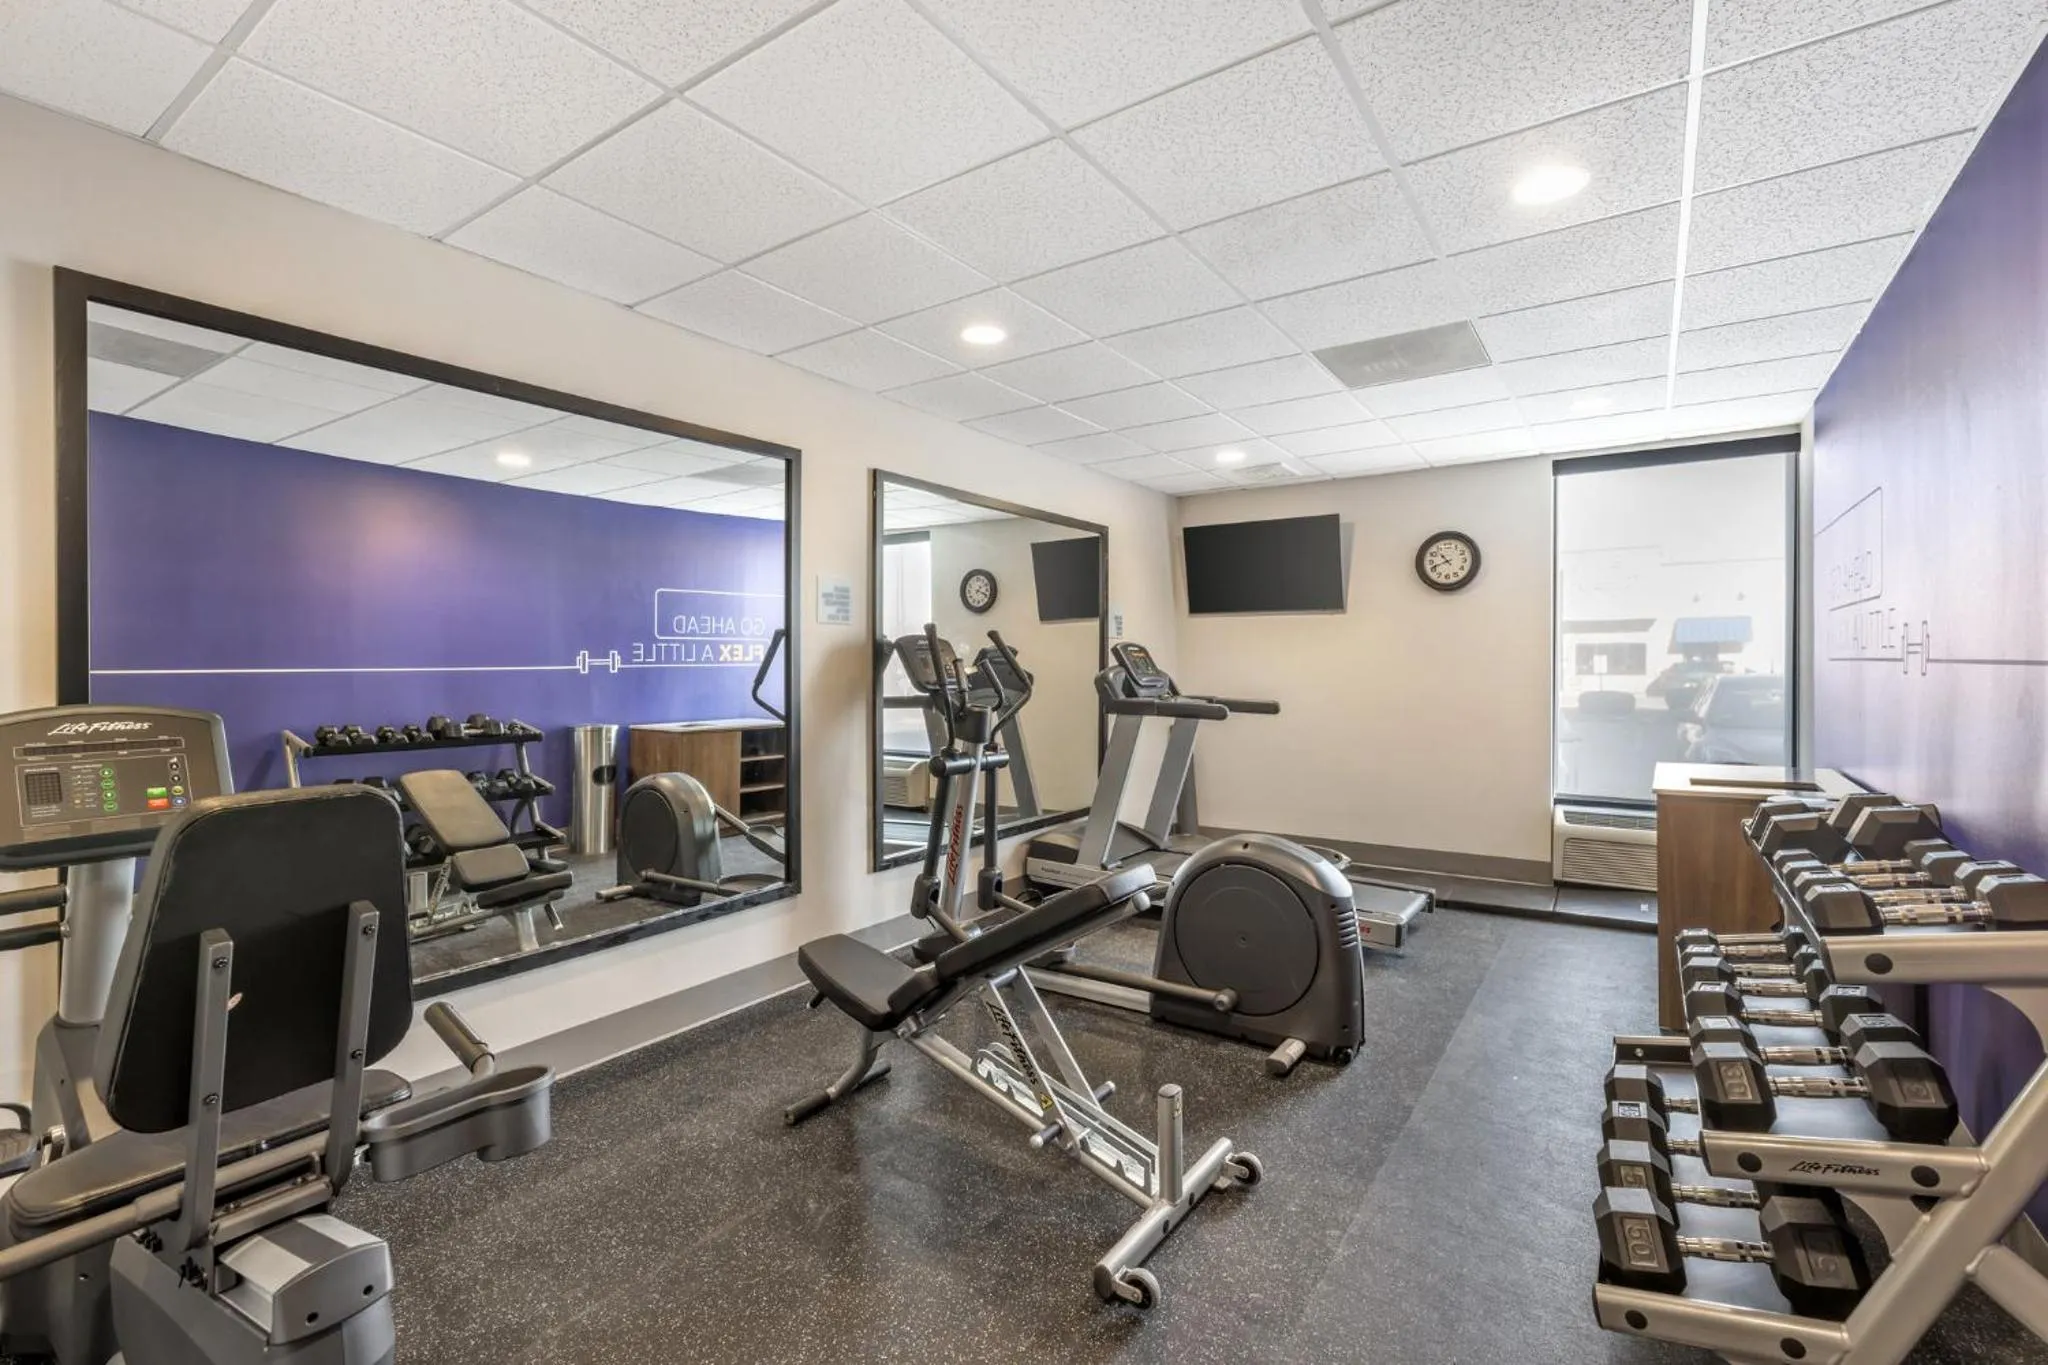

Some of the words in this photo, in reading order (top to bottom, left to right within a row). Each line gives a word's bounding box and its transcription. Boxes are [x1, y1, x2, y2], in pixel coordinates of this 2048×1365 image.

[47, 722, 88, 736] Life
[86, 721, 153, 734] Fitness
[986, 1001, 1011, 1031] Life
[1003, 1031, 1039, 1085] Fitness
[1789, 1161, 1819, 1174] Life
[1821, 1163, 1881, 1176] Fitness
[1625, 1220, 1651, 1259] 50
